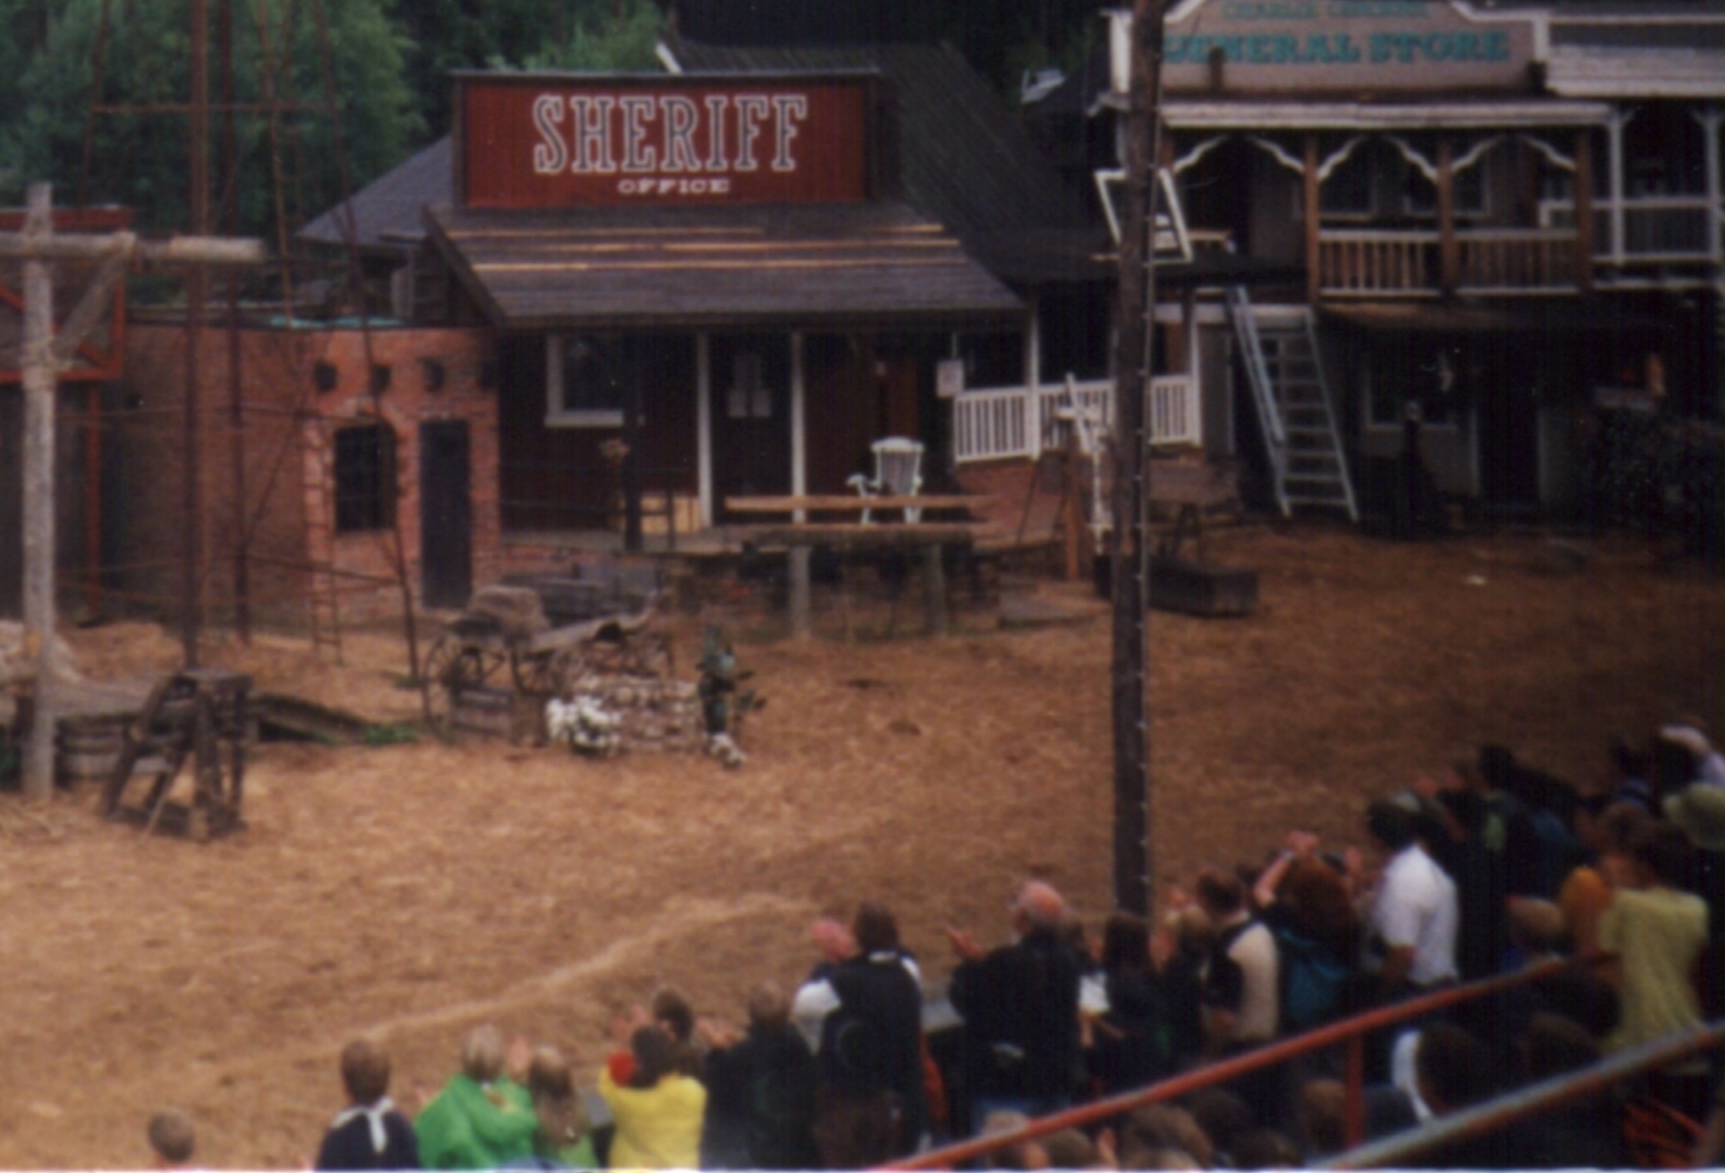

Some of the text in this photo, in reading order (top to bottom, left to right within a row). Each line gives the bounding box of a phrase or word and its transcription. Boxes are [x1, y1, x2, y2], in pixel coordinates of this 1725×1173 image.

[1369, 31, 1510, 63] STORE
[533, 94, 808, 173] SHERIFF
[617, 179, 731, 194] OFFICE
